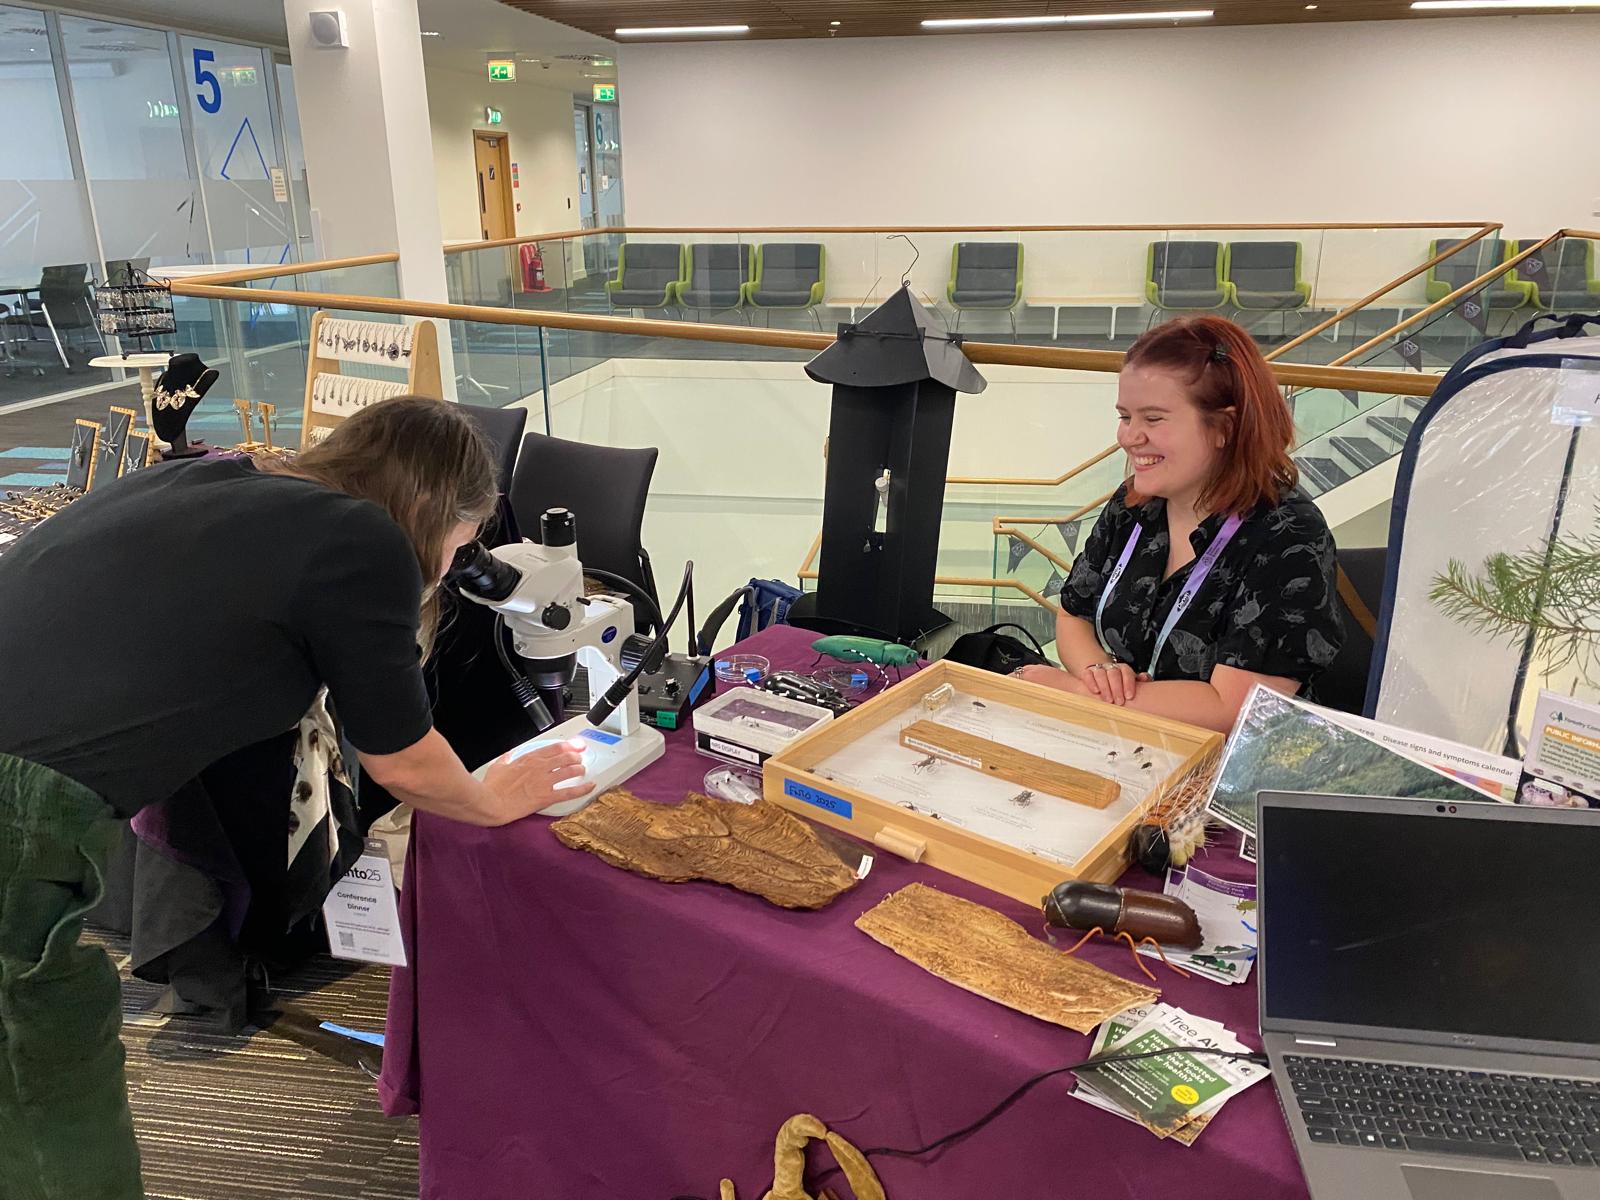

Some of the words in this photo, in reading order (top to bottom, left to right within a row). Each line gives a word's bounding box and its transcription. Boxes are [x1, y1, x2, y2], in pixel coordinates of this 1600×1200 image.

[193, 48, 222, 114] 5
[595, 112, 604, 145] 6
[1545, 726, 1570, 739] PUBLIC
[1382, 735, 1409, 748] Disease
[1409, 743, 1427, 754] signs
[1428, 748, 1442, 757] and
[1443, 753, 1480, 769] symptoms
[1481, 764, 1514, 777] calendar
[343, 867, 381, 881] nto25
[336, 891, 377, 904] Conference
[347, 903, 370, 912] Dinner
[1151, 1034, 1169, 1048] Have
[1185, 1056, 1218, 1082] spotted
[1169, 1016, 1198, 1038] Tree
[1198, 1037, 1238, 1065] Alt
[1136, 1042, 1145, 1050] in
[1144, 1047, 1164, 1062] por
[1163, 1061, 1194, 1084] health?
[1150, 1042, 1162, 1052] tre
[1166, 1054, 1184, 1066] that
[1184, 1064, 1206, 1084] looks
